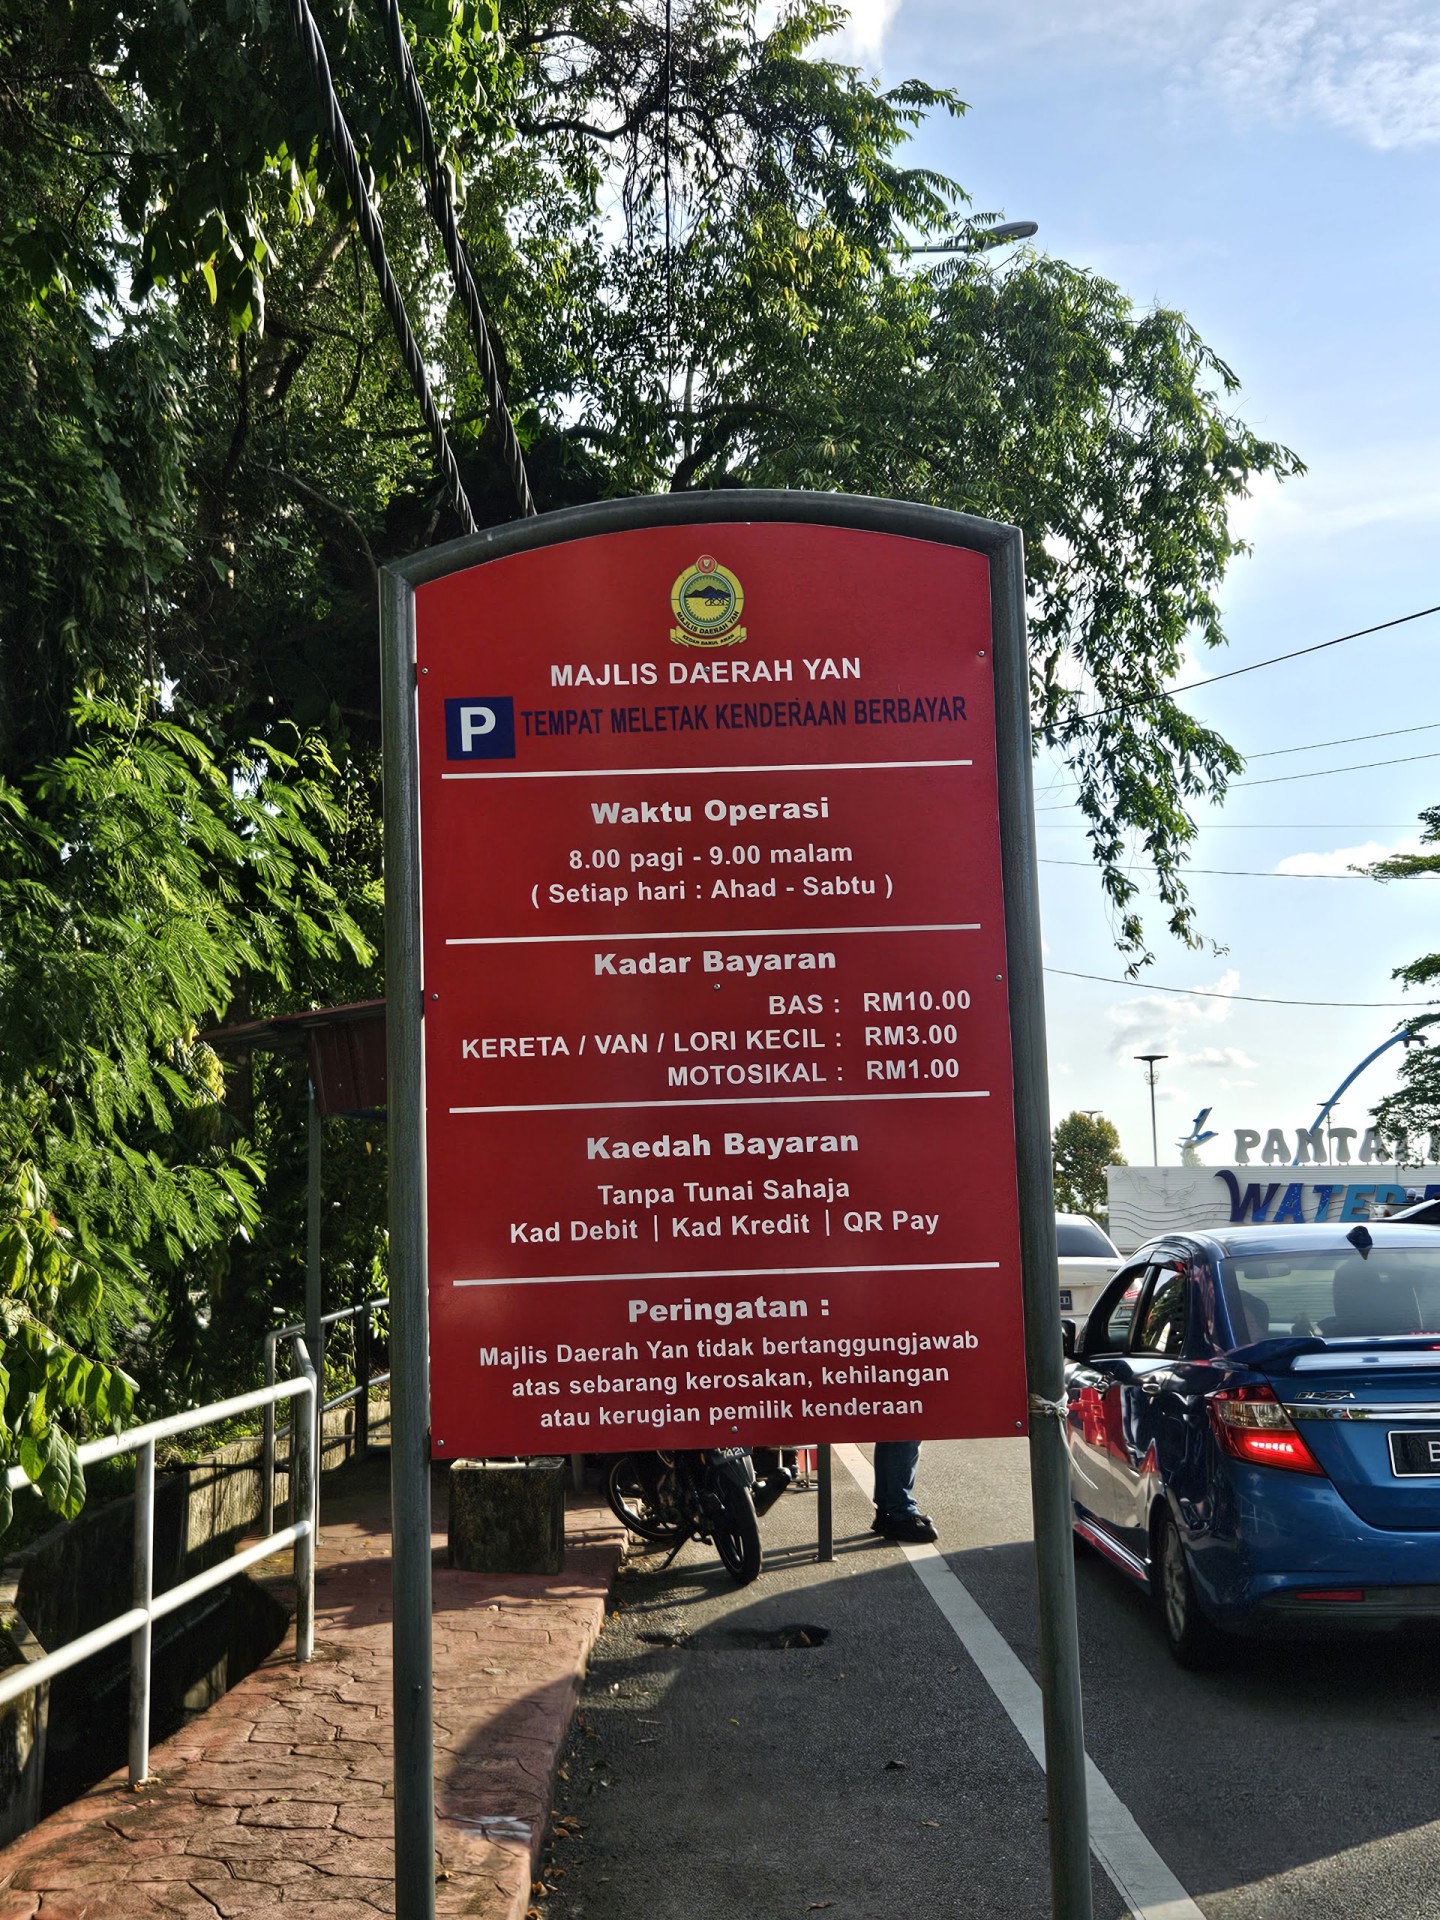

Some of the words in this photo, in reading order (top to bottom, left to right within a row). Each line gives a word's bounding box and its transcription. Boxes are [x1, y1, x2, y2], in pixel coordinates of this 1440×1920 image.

[550, 662, 658, 687] MAJLIS
[669, 659, 793, 684] DAERAH
[802, 657, 861, 681] YAN
[460, 706, 496, 752] P
[520, 709, 603, 736] TEMPAT
[610, 704, 709, 733] MELETAK
[715, 699, 847, 729] KENDERAAN
[853, 695, 967, 725] BERBAYAR
[590, 801, 692, 825] Waktu
[704, 796, 829, 827] Operasi
[569, 848, 621, 870] 8.00
[630, 846, 683, 873] pagi
[709, 844, 761, 866] 9.00
[770, 843, 853, 864] malam
[548, 882, 629, 907] Setiap
[638, 880, 686, 901] hari
[710, 877, 776, 899] Ahad
[803, 875, 876, 896] Sabtu
[594, 952, 692, 976] Kadar
[703, 950, 836, 977] Bayaran
[769, 994, 824, 1015] BAS
[863, 989, 971, 1012] RM10.00
[462, 1036, 570, 1059] KERETA
[594, 1033, 648, 1055] VAN
[674, 1030, 736, 1052] LORI
[746, 1028, 826, 1050] KECIL
[865, 1024, 958, 1046] RM3.00
[668, 1062, 827, 1087] MOTOSIKAL
[866, 1058, 959, 1080] RM1.00
[587, 1133, 711, 1160] Kaedah
[724, 1132, 859, 1160] Bayaran
[597, 1184, 675, 1209] Tanpa
[683, 1180, 753, 1203] Tunai
[763, 1177, 850, 1203] Sahaja
[510, 1221, 560, 1244] Kad
[570, 1219, 639, 1241] Debit
[672, 1216, 722, 1238] Kad
[731, 1213, 810, 1236] Kredit
[843, 1211, 884, 1233] QR
[892, 1210, 940, 1235] Pay
[628, 1295, 808, 1326] Peringatan
[479, 1345, 548, 1370] Majlis
[557, 1341, 639, 1363] Daerah
[646, 1340, 689, 1359] Yan
[696, 1337, 754, 1358] tidak
[762, 1330, 979, 1358] bertanggungjawab
[512, 1378, 561, 1397] atas
[569, 1374, 677, 1396] sebarang
[686, 1368, 813, 1390] kerosakan,
[821, 1365, 949, 1387] kehilangan
[540, 1409, 590, 1428] atau
[599, 1403, 700, 1428] kerugian
[709, 1399, 794, 1425] pemilik
[801, 1397, 923, 1418] kenderaan
